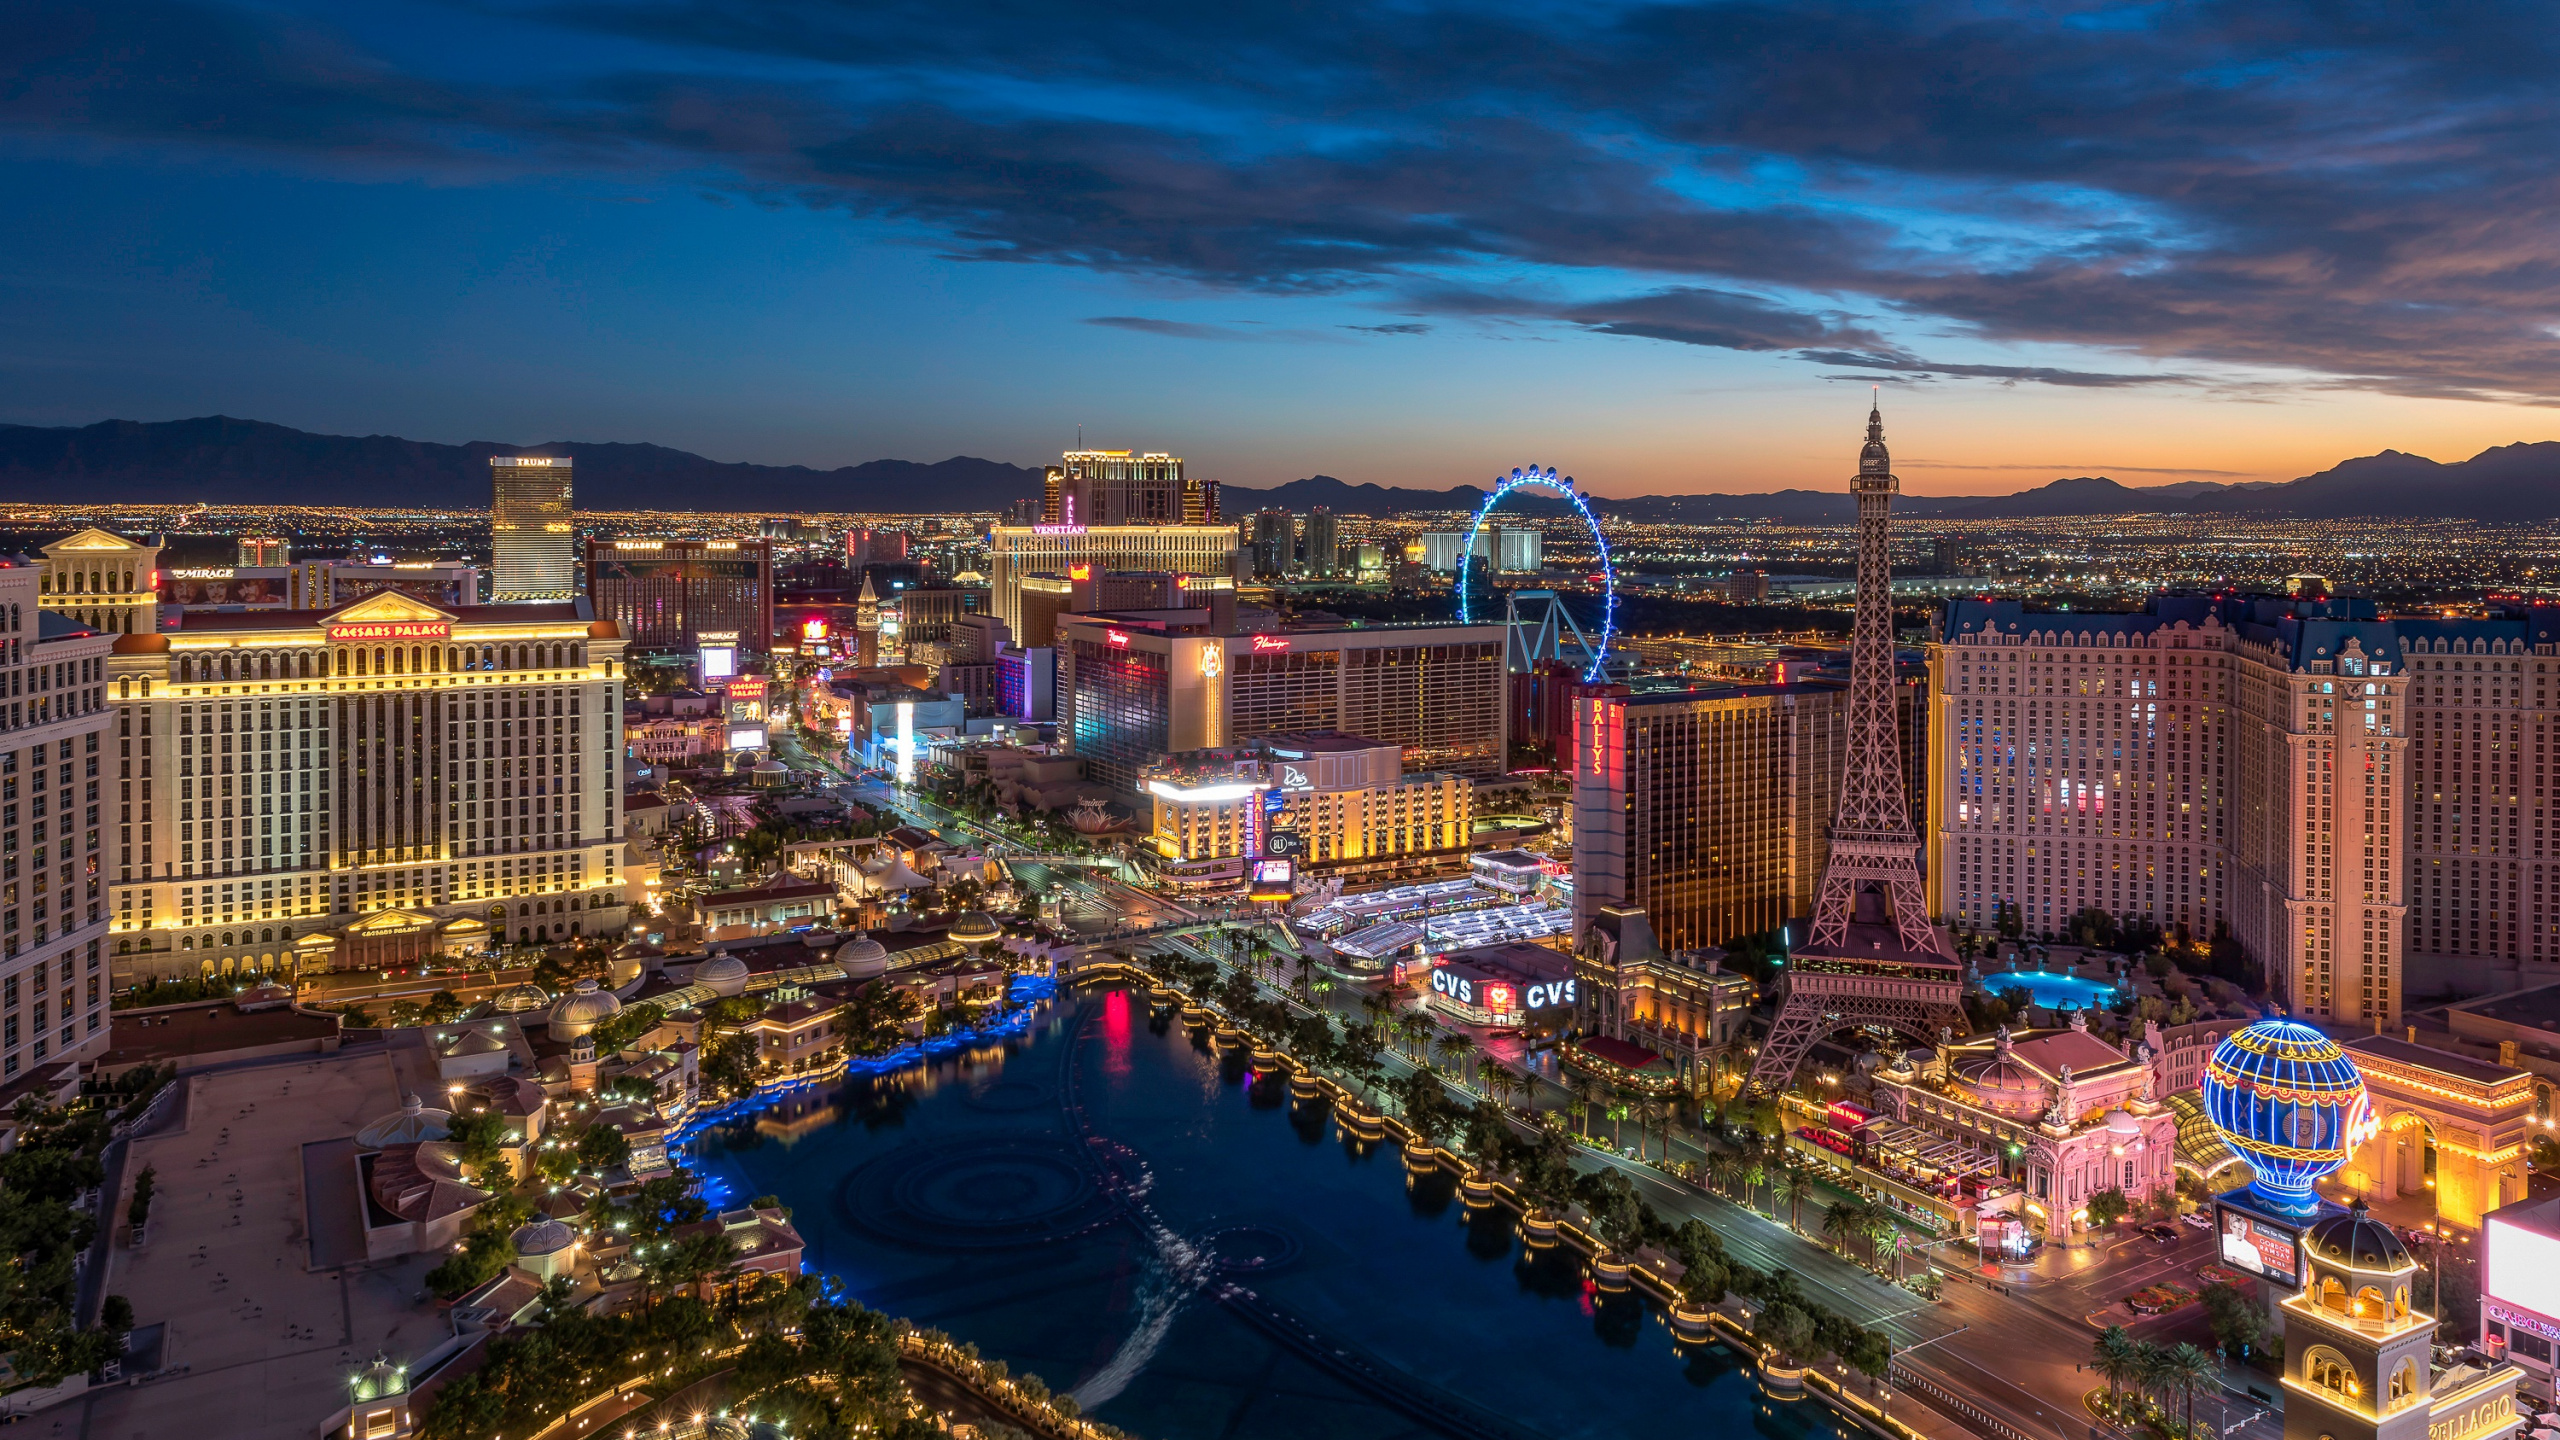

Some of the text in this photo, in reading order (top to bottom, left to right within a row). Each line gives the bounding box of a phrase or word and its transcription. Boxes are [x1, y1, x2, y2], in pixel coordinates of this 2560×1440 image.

[516, 458, 553, 466] TRUMP
[1034, 526, 1085, 534] VENETIAN
[615, 542, 738, 550] TREASURE ISLAND
[184, 569, 234, 578] MIRAGE
[331, 624, 446, 638] CAESARS PALACE
[1253, 635, 1290, 650] Flamingo
[730, 682, 763, 690] CAESARS
[731, 689, 762, 697] PALACE
[1273, 839, 1284, 850] BLT
[1432, 969, 1472, 1003] CVS
[1527, 979, 1575, 1008] CVS
[2351, 1055, 2423, 1080] MONUMENTAL
[2429, 1076, 2476, 1094] FLAVORS
[1828, 1104, 1863, 1123] BEER PARK
[2259, 1238, 2291, 1254] GORDON
[2259, 1245, 2291, 1260] RAMSAY
[2264, 1256, 2287, 1268] steak
[2488, 1305, 2540, 1332] CABO
